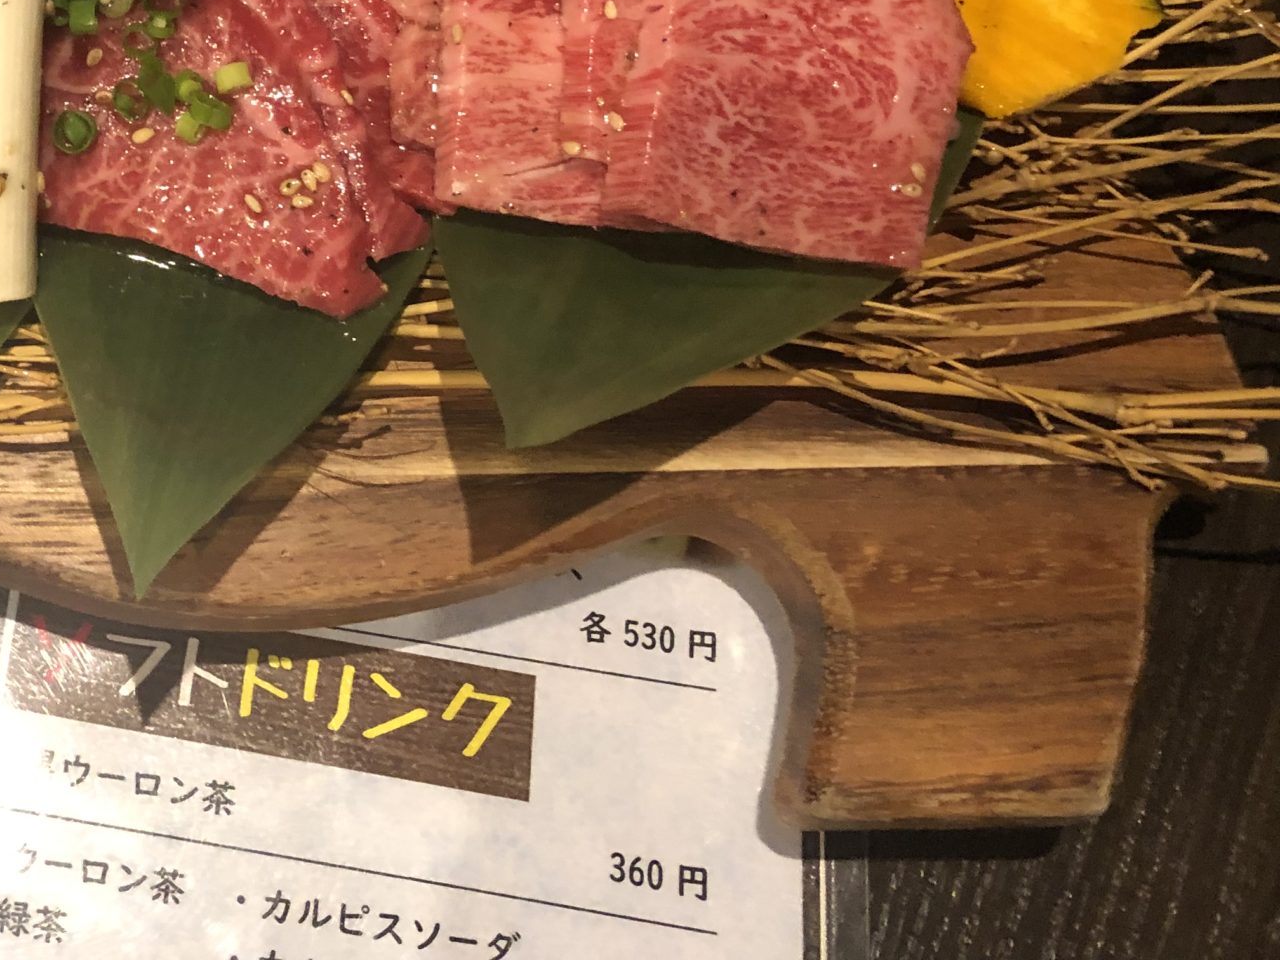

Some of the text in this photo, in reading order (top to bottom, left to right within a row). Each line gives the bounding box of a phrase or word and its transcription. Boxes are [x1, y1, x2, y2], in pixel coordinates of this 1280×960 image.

[580, 611, 717, 662] 各 530 円
[609, 851, 708, 902] 360 円
